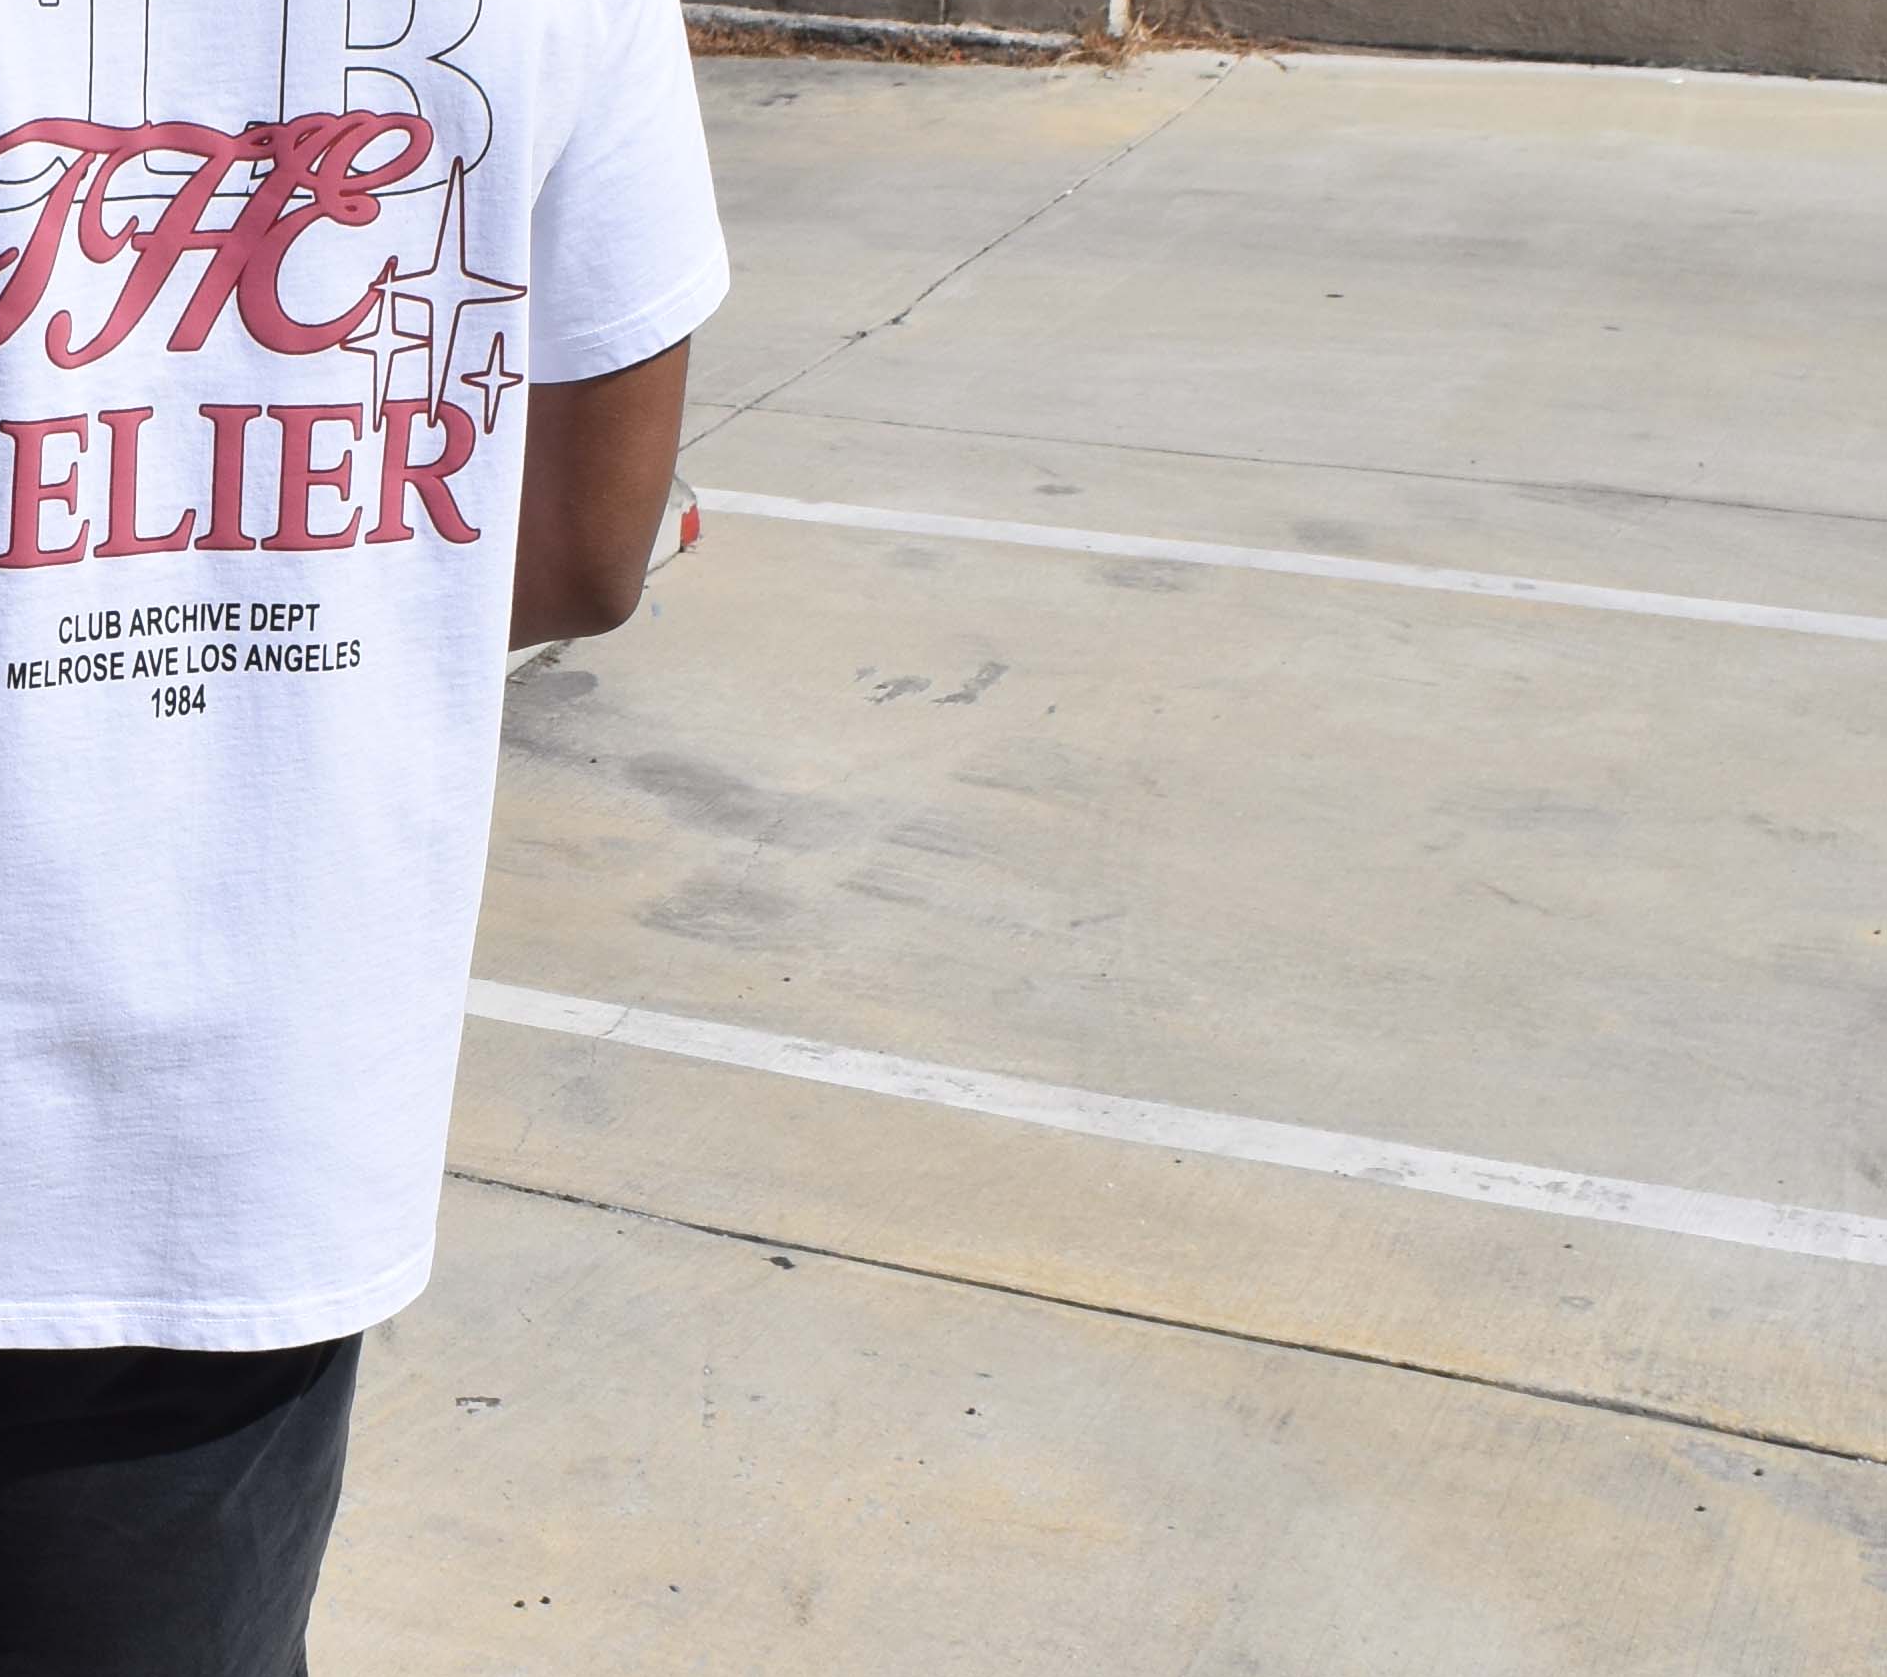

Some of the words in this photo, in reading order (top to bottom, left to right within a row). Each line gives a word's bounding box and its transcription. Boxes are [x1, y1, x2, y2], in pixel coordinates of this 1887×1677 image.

[58, 611, 122, 644] CLUB
[129, 603, 241, 637] ARCHIVE
[250, 603, 320, 632] DEPT
[6, 652, 125, 690] MELROSE
[132, 647, 179, 679] AVE
[186, 643, 238, 674] LOS
[244, 639, 361, 673] ANGELES
[151, 684, 206, 718] 1984
